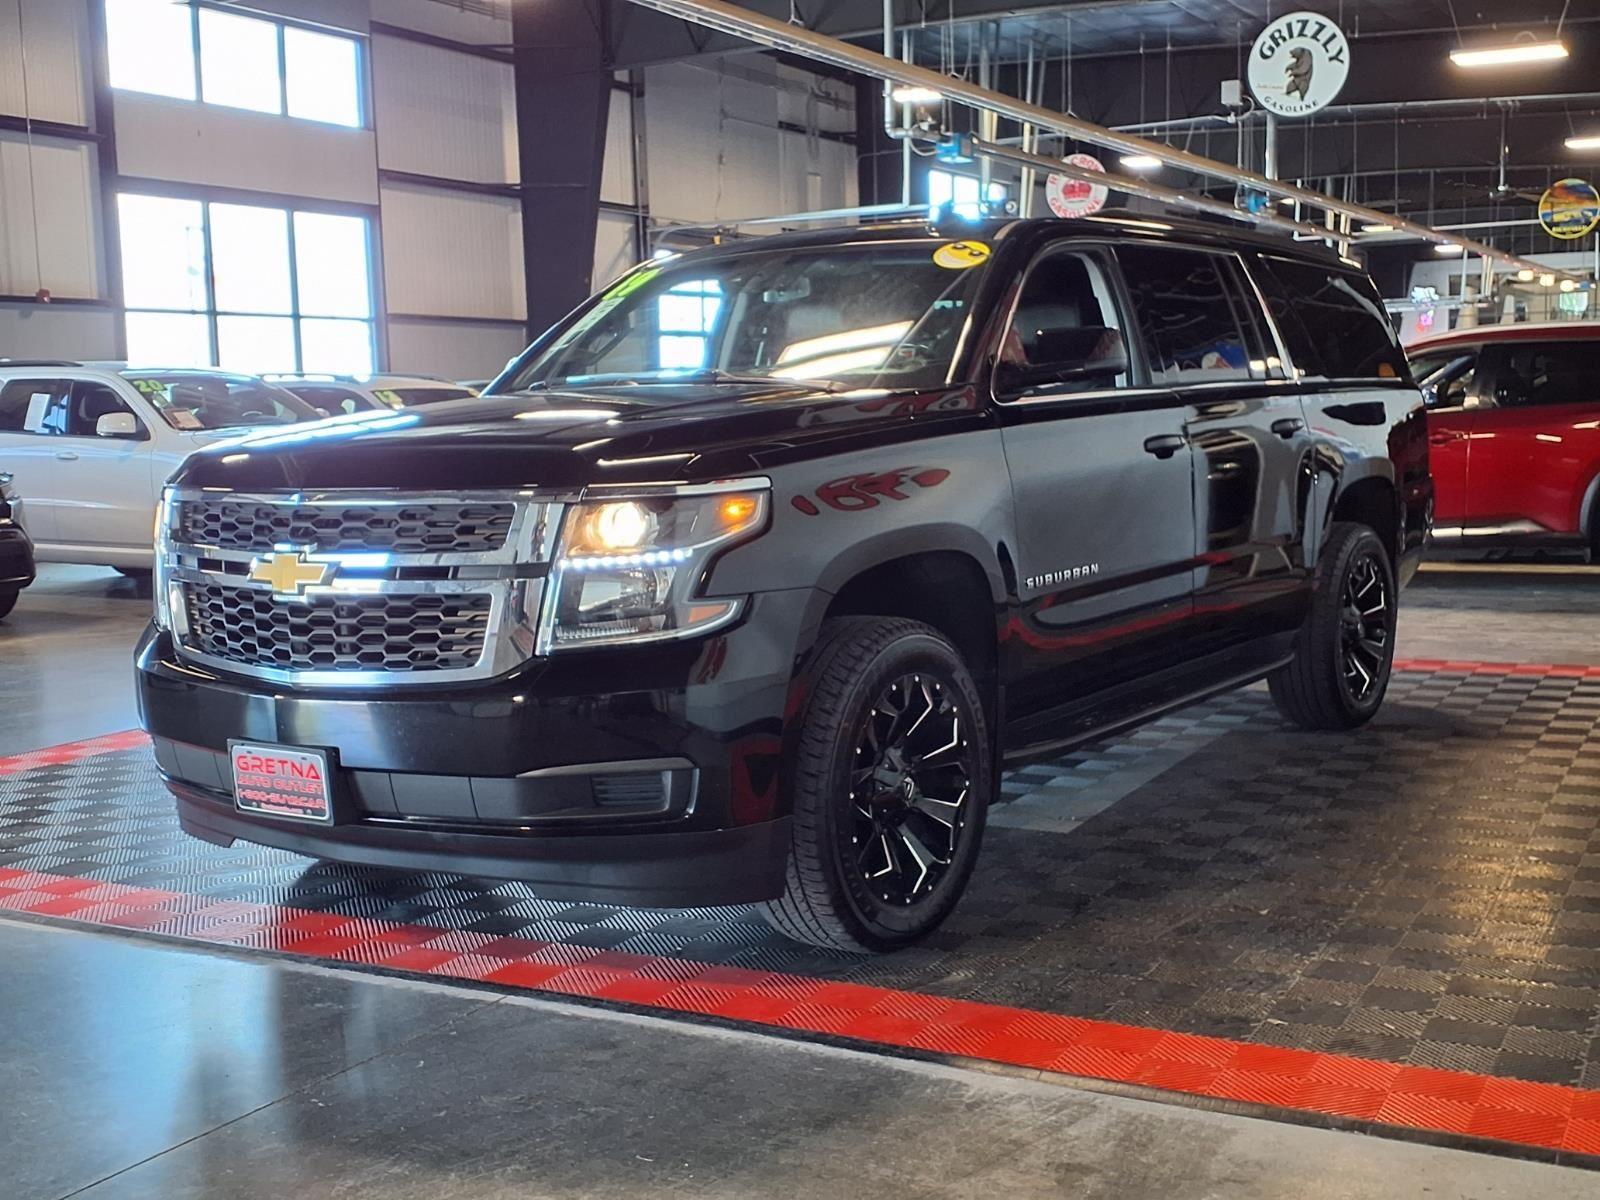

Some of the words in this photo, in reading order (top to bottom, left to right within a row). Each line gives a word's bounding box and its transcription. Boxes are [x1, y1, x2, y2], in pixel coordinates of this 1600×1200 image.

[1259, 19, 1345, 65] GRIZZLY
[1264, 96, 1319, 113] GASOLINE
[133, 380, 165, 393] 20
[1026, 563, 1099, 589] SUBURBAN
[237, 755, 321, 780] GRETNA
